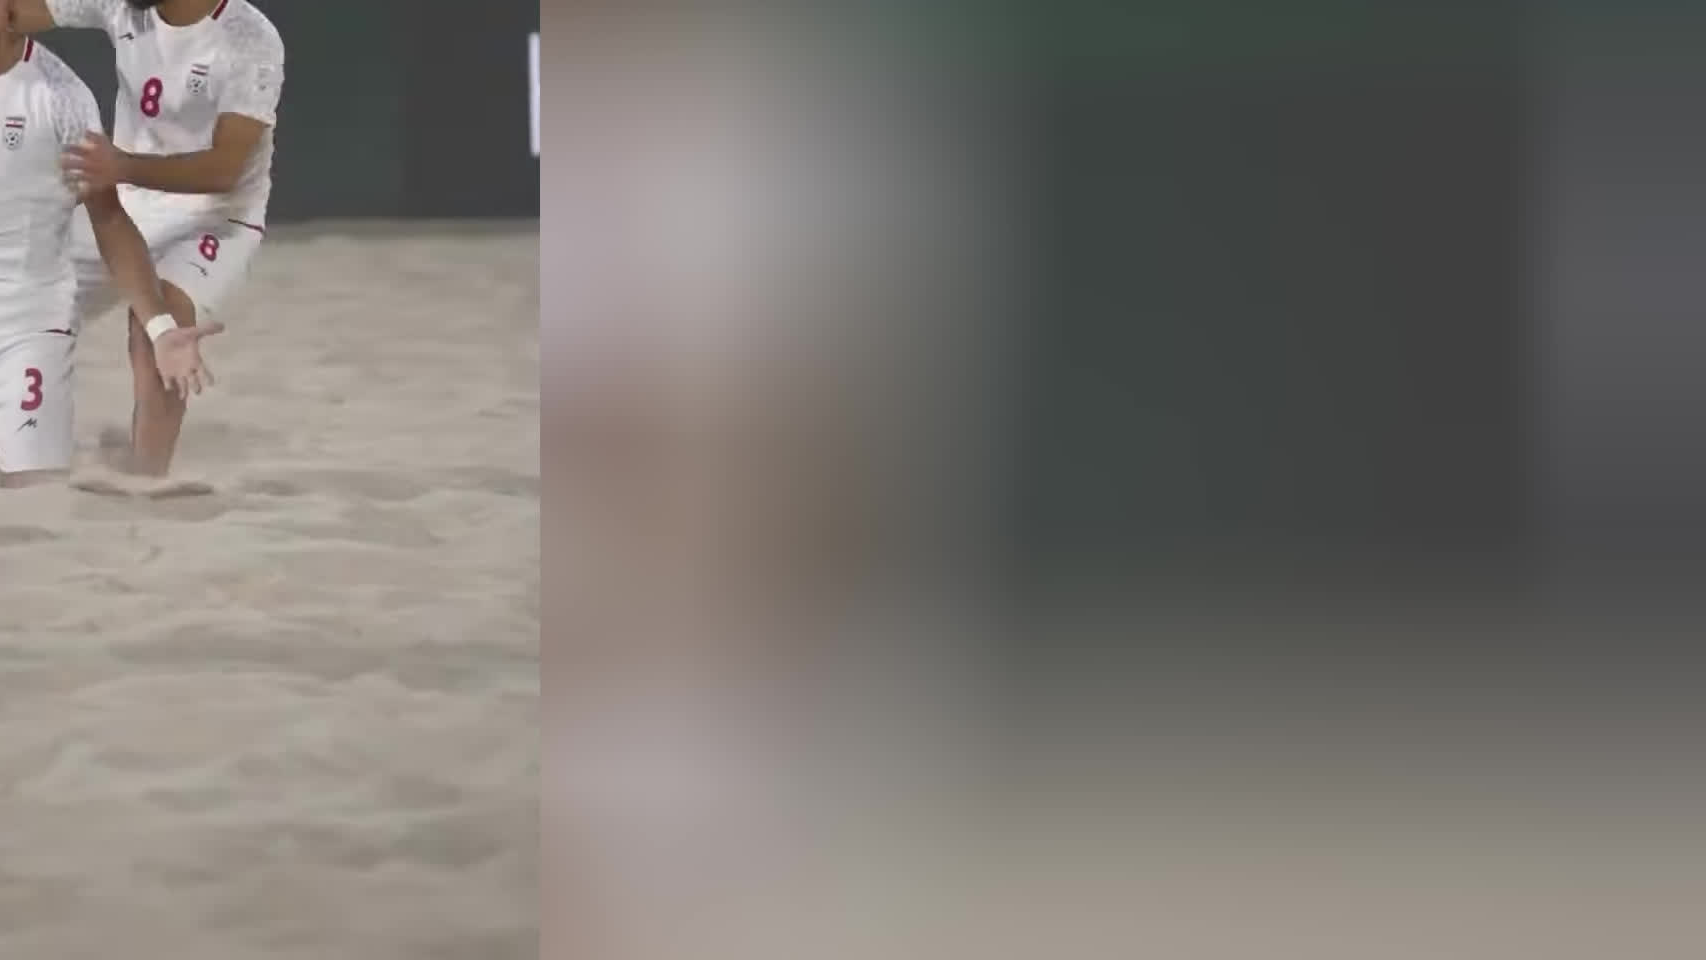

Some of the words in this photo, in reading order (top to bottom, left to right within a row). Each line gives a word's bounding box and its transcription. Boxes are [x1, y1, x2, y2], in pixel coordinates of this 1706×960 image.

[140, 76, 163, 117] 8
[198, 234, 219, 261] 8
[20, 368, 44, 411] 3
